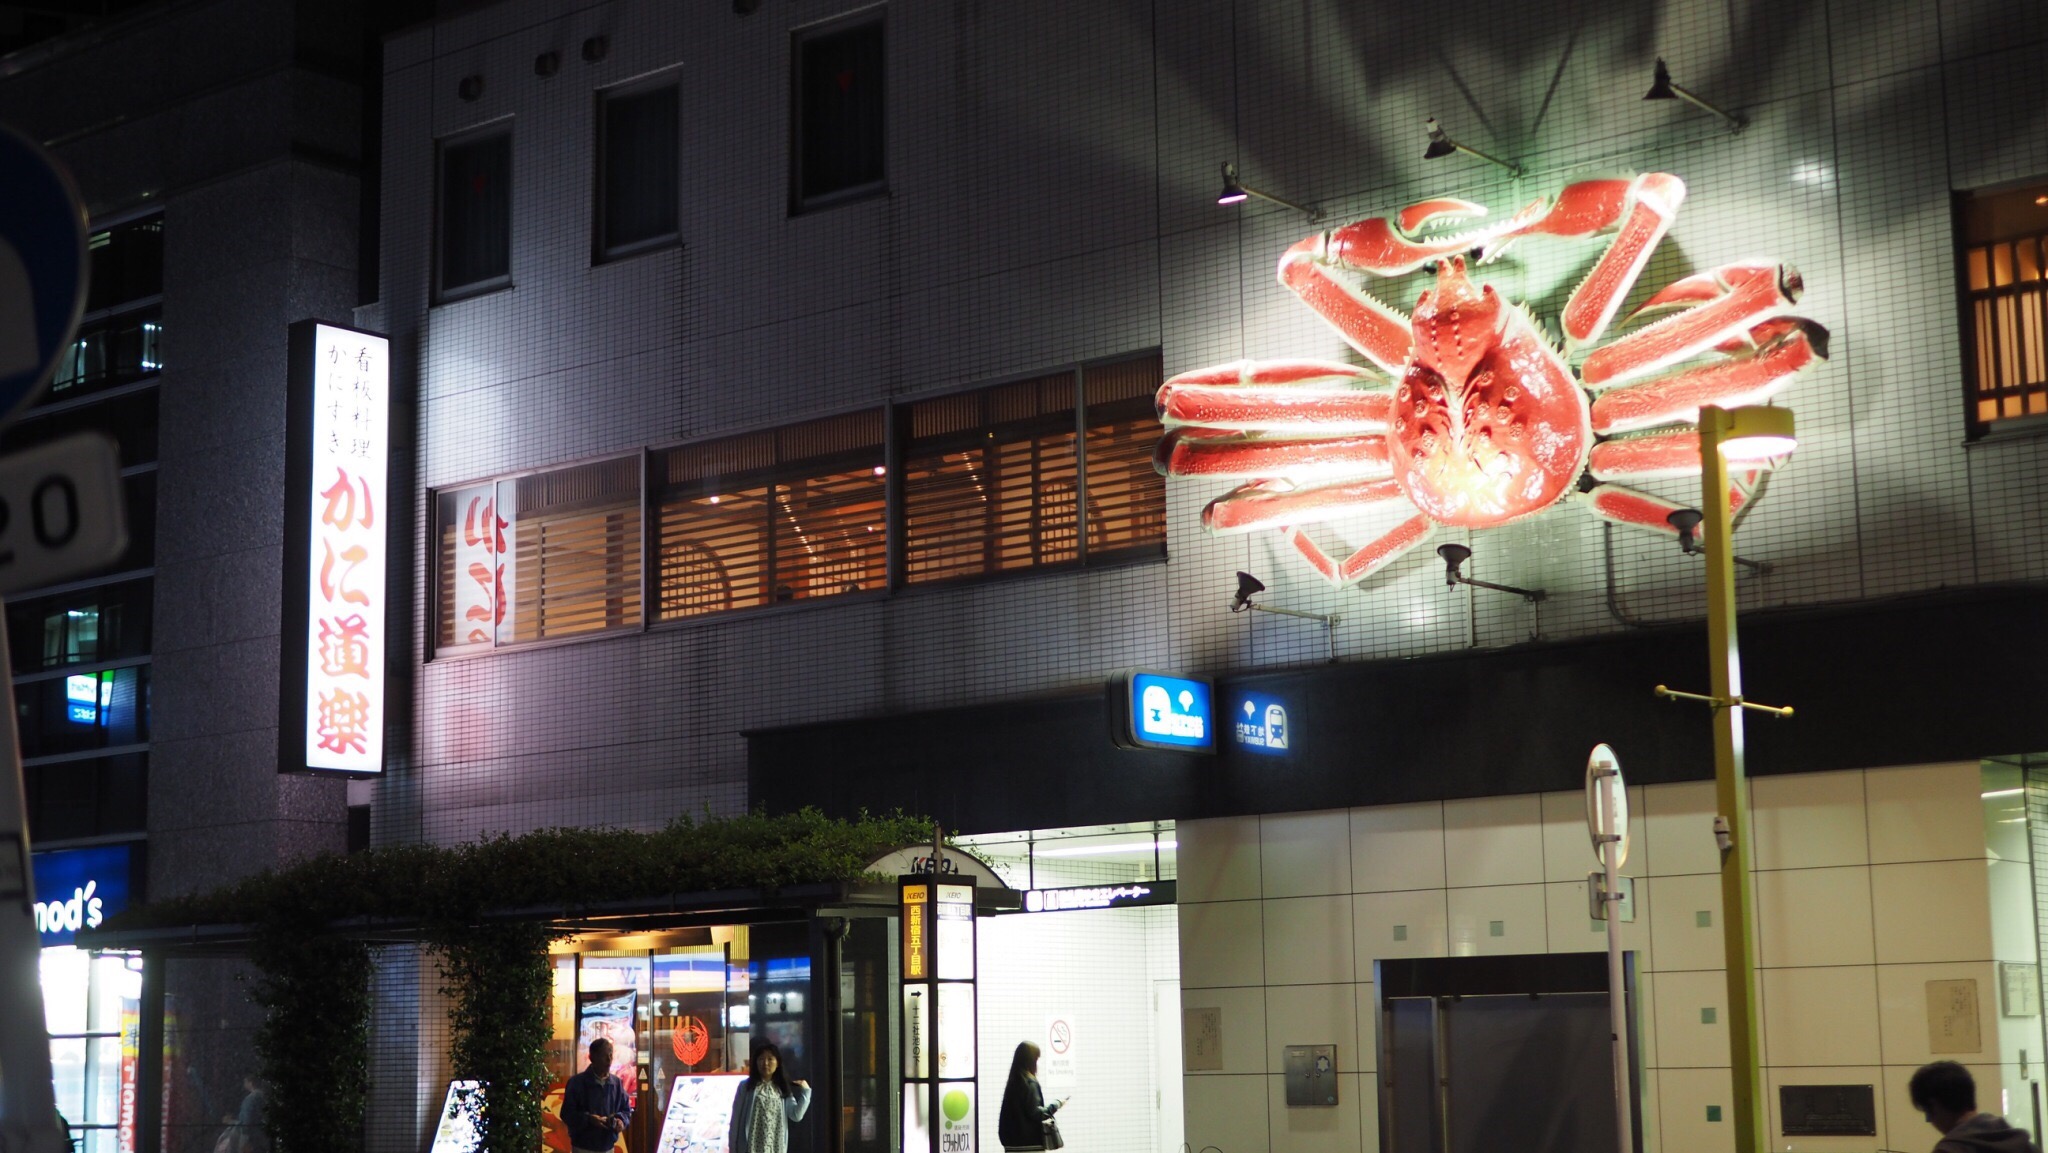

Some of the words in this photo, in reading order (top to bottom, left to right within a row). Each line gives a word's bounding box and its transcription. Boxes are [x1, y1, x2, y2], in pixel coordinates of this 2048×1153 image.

[327, 344, 347, 455] かにすき
[351, 346, 373, 459] 看板料理
[911, 857, 951, 875] KEO
[906, 891, 925, 900] KEIO
[945, 891, 962, 899] KEIO
[910, 905, 922, 976] 西新宿五丁目駅
